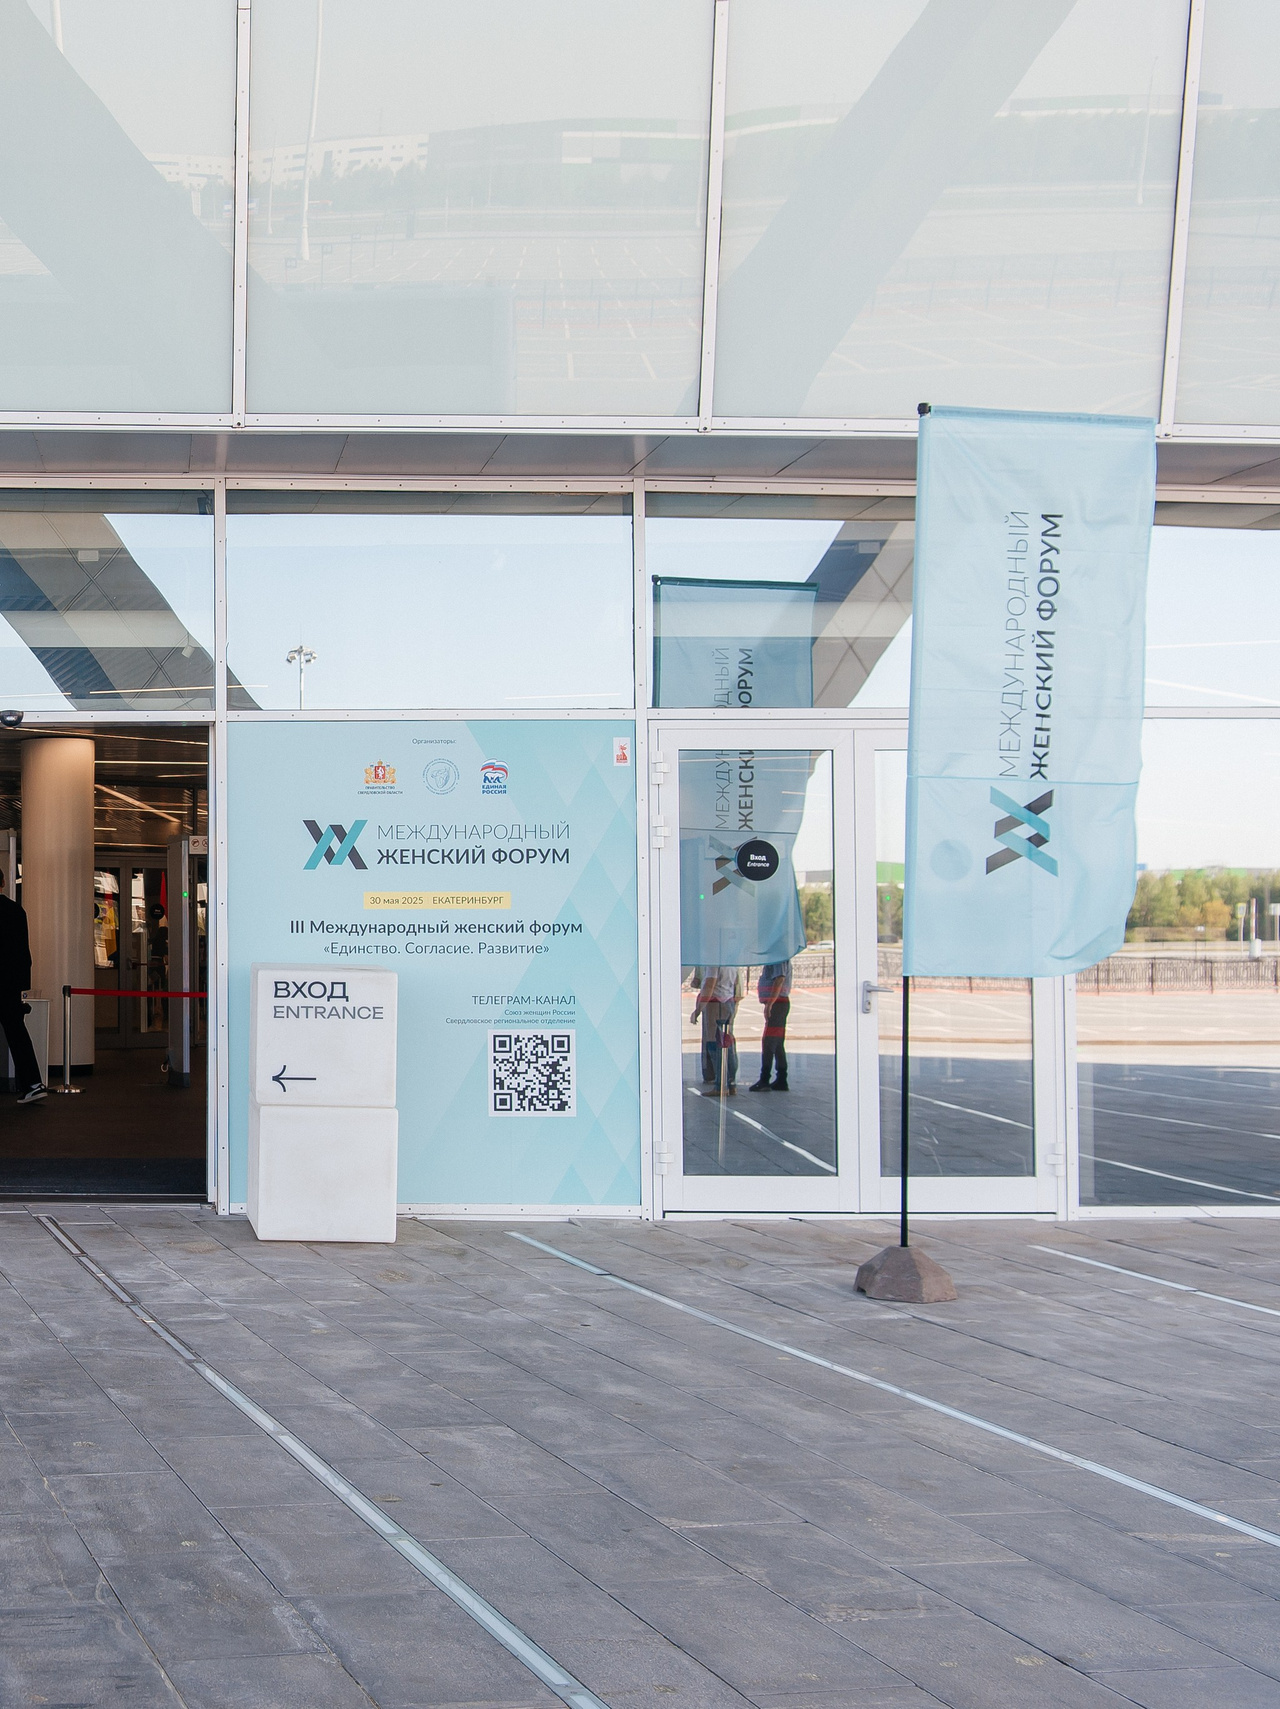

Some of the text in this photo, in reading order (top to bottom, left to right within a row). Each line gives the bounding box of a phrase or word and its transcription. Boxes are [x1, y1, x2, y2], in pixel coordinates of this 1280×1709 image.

[998, 509, 1031, 779] МЕЖДУНАРОДНЫЙ
[1029, 512, 1064, 780] ЖЕНСКИЙ ФОРУМ
[738, 648, 754, 708] ОРУМ
[377, 821, 571, 843] МЕЖДУНАРОДНЫЙ
[377, 845, 571, 865] ЖЕНСКИЙ ФОРУМ
[369, 896, 504, 905] 30 мая 2025 ЕКАТЕРИНБУРГ
[310, 917, 449, 937] Международный
[453, 918, 525, 935] женский
[528, 920, 583, 940] форум
[322, 941, 550, 956] «Единство. Согласие. Развитие»
[274, 981, 349, 1002] ВХОД
[472, 995, 576, 1005] ТЕЛЕГРАМ-КАНАЛ
[274, 1006, 384, 1020] ENTRANCE
[493, 1017, 539, 1025] региональное
[540, 1017, 576, 1025] отделение
[523, 1009, 551, 1017] женщин
